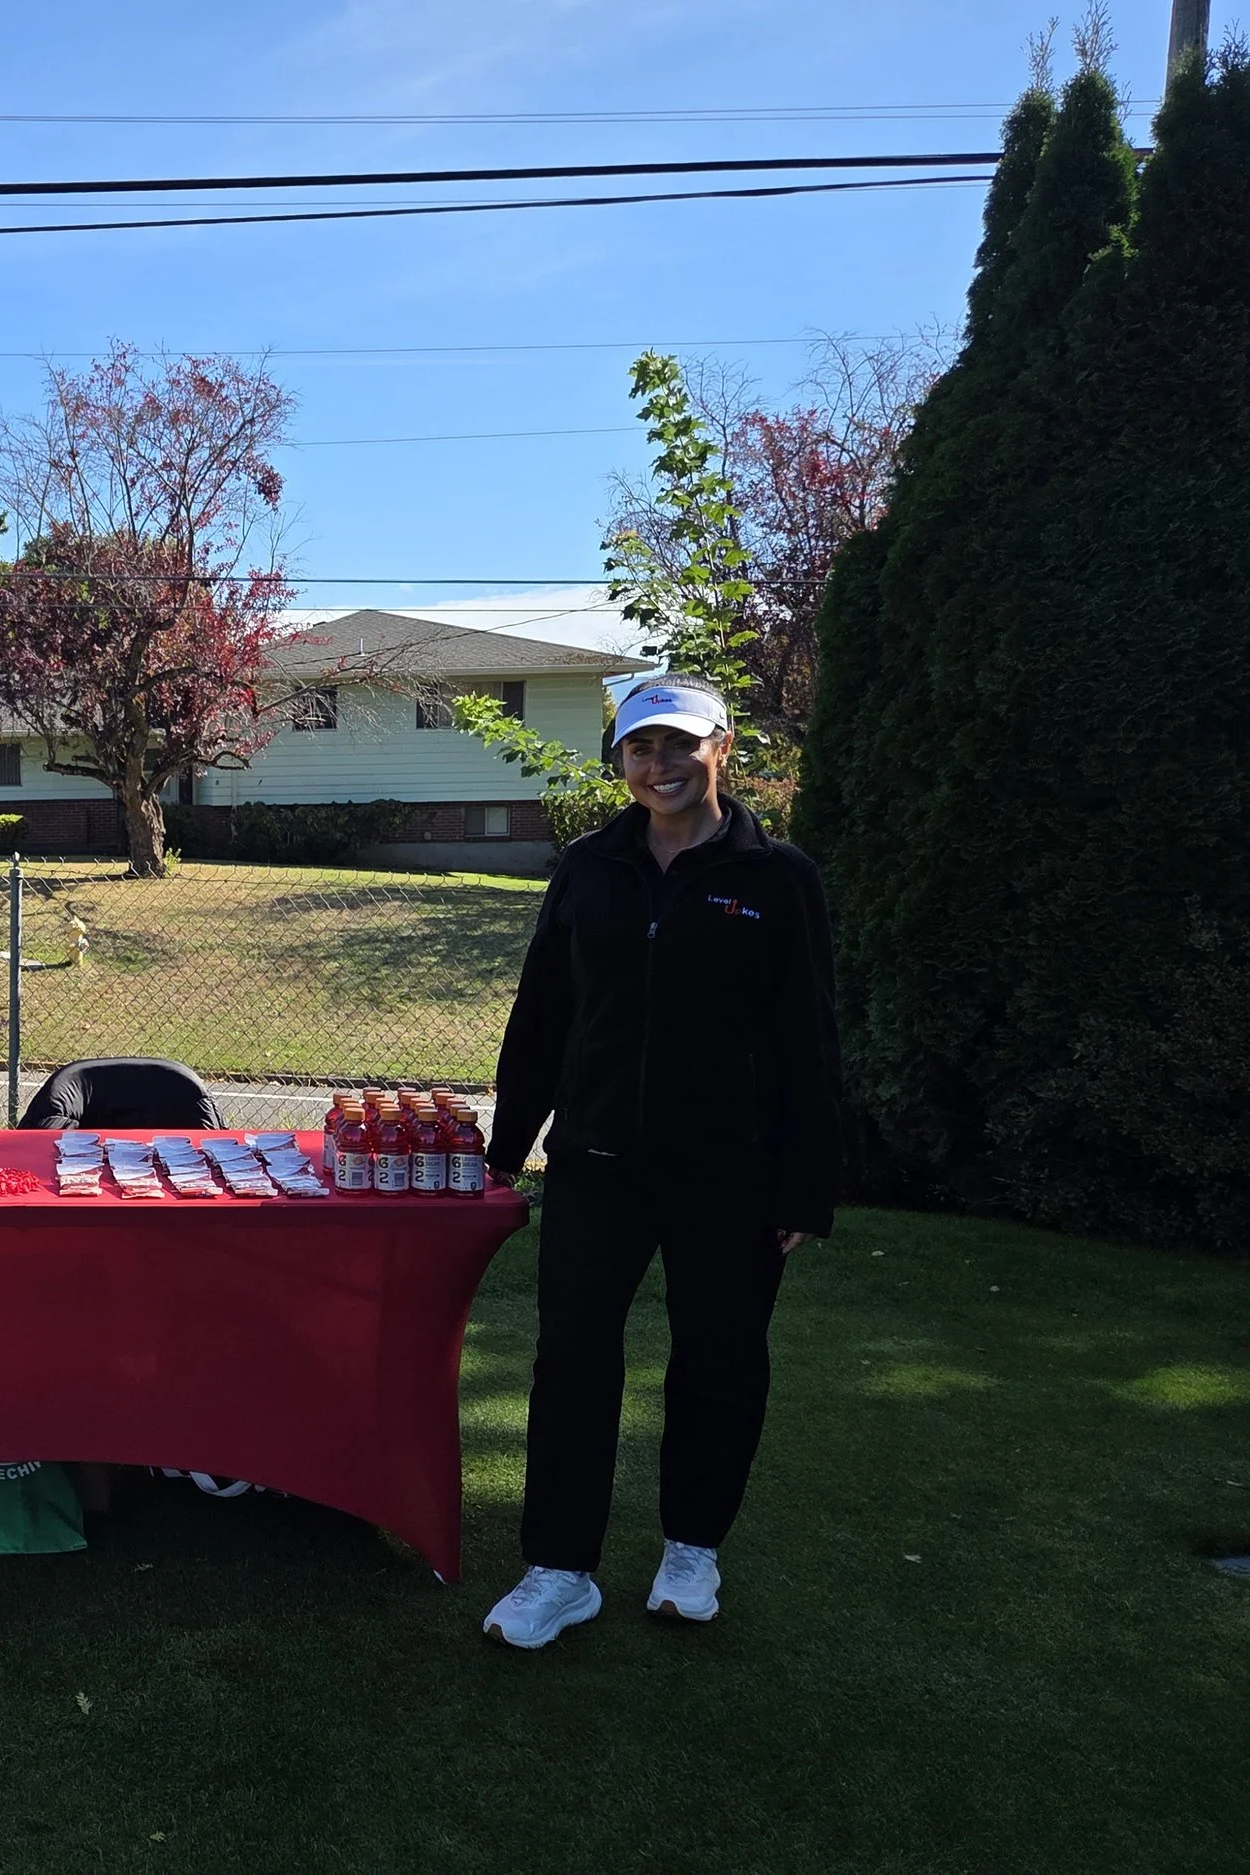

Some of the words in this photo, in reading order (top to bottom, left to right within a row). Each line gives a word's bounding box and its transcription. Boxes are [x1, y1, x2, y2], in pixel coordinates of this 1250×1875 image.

[708, 894, 731, 905] Level
[338, 1169, 346, 1181] 2
[379, 1171, 389, 1183] 2
[415, 1170, 424, 1182] 2
[452, 1171, 461, 1183] 2
